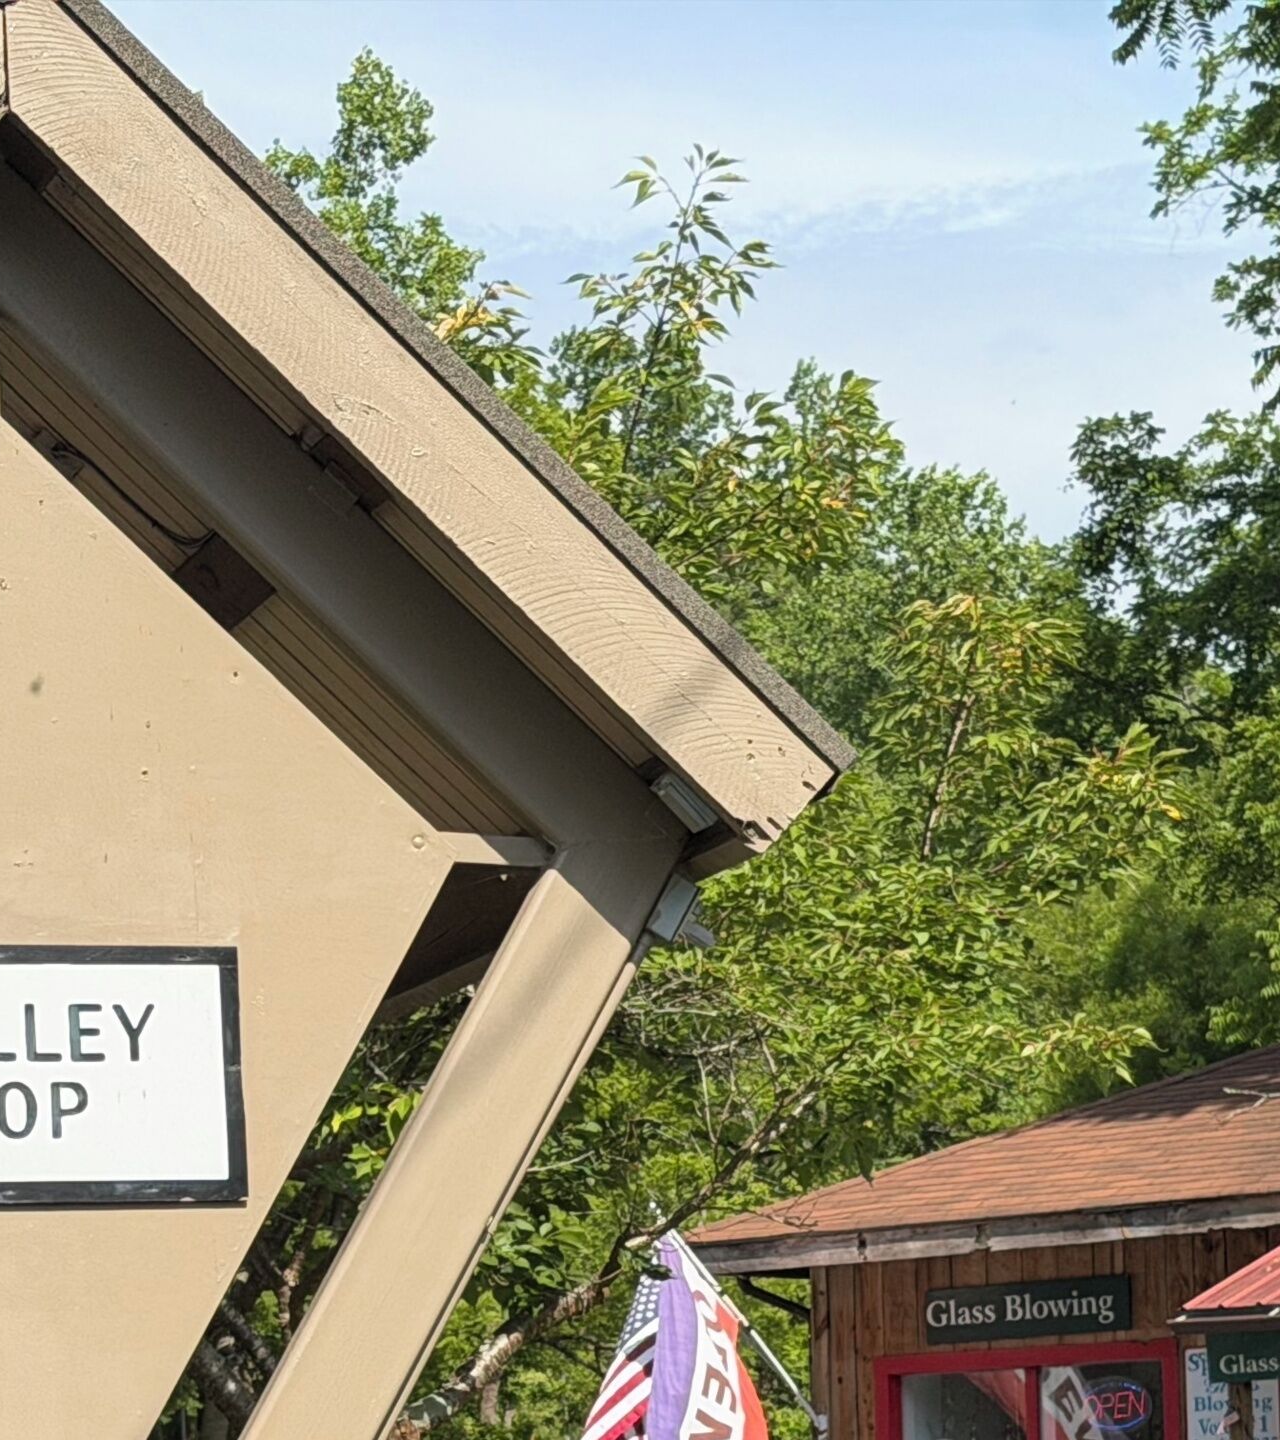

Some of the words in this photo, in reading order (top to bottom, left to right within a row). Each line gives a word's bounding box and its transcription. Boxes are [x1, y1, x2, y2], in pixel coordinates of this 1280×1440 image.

[926, 1299, 996, 1328] Glass
[1004, 1290, 1115, 1325] Blowing
[1220, 1353, 1280, 1375] Glass
[1086, 1390, 1146, 1420] OPEN
